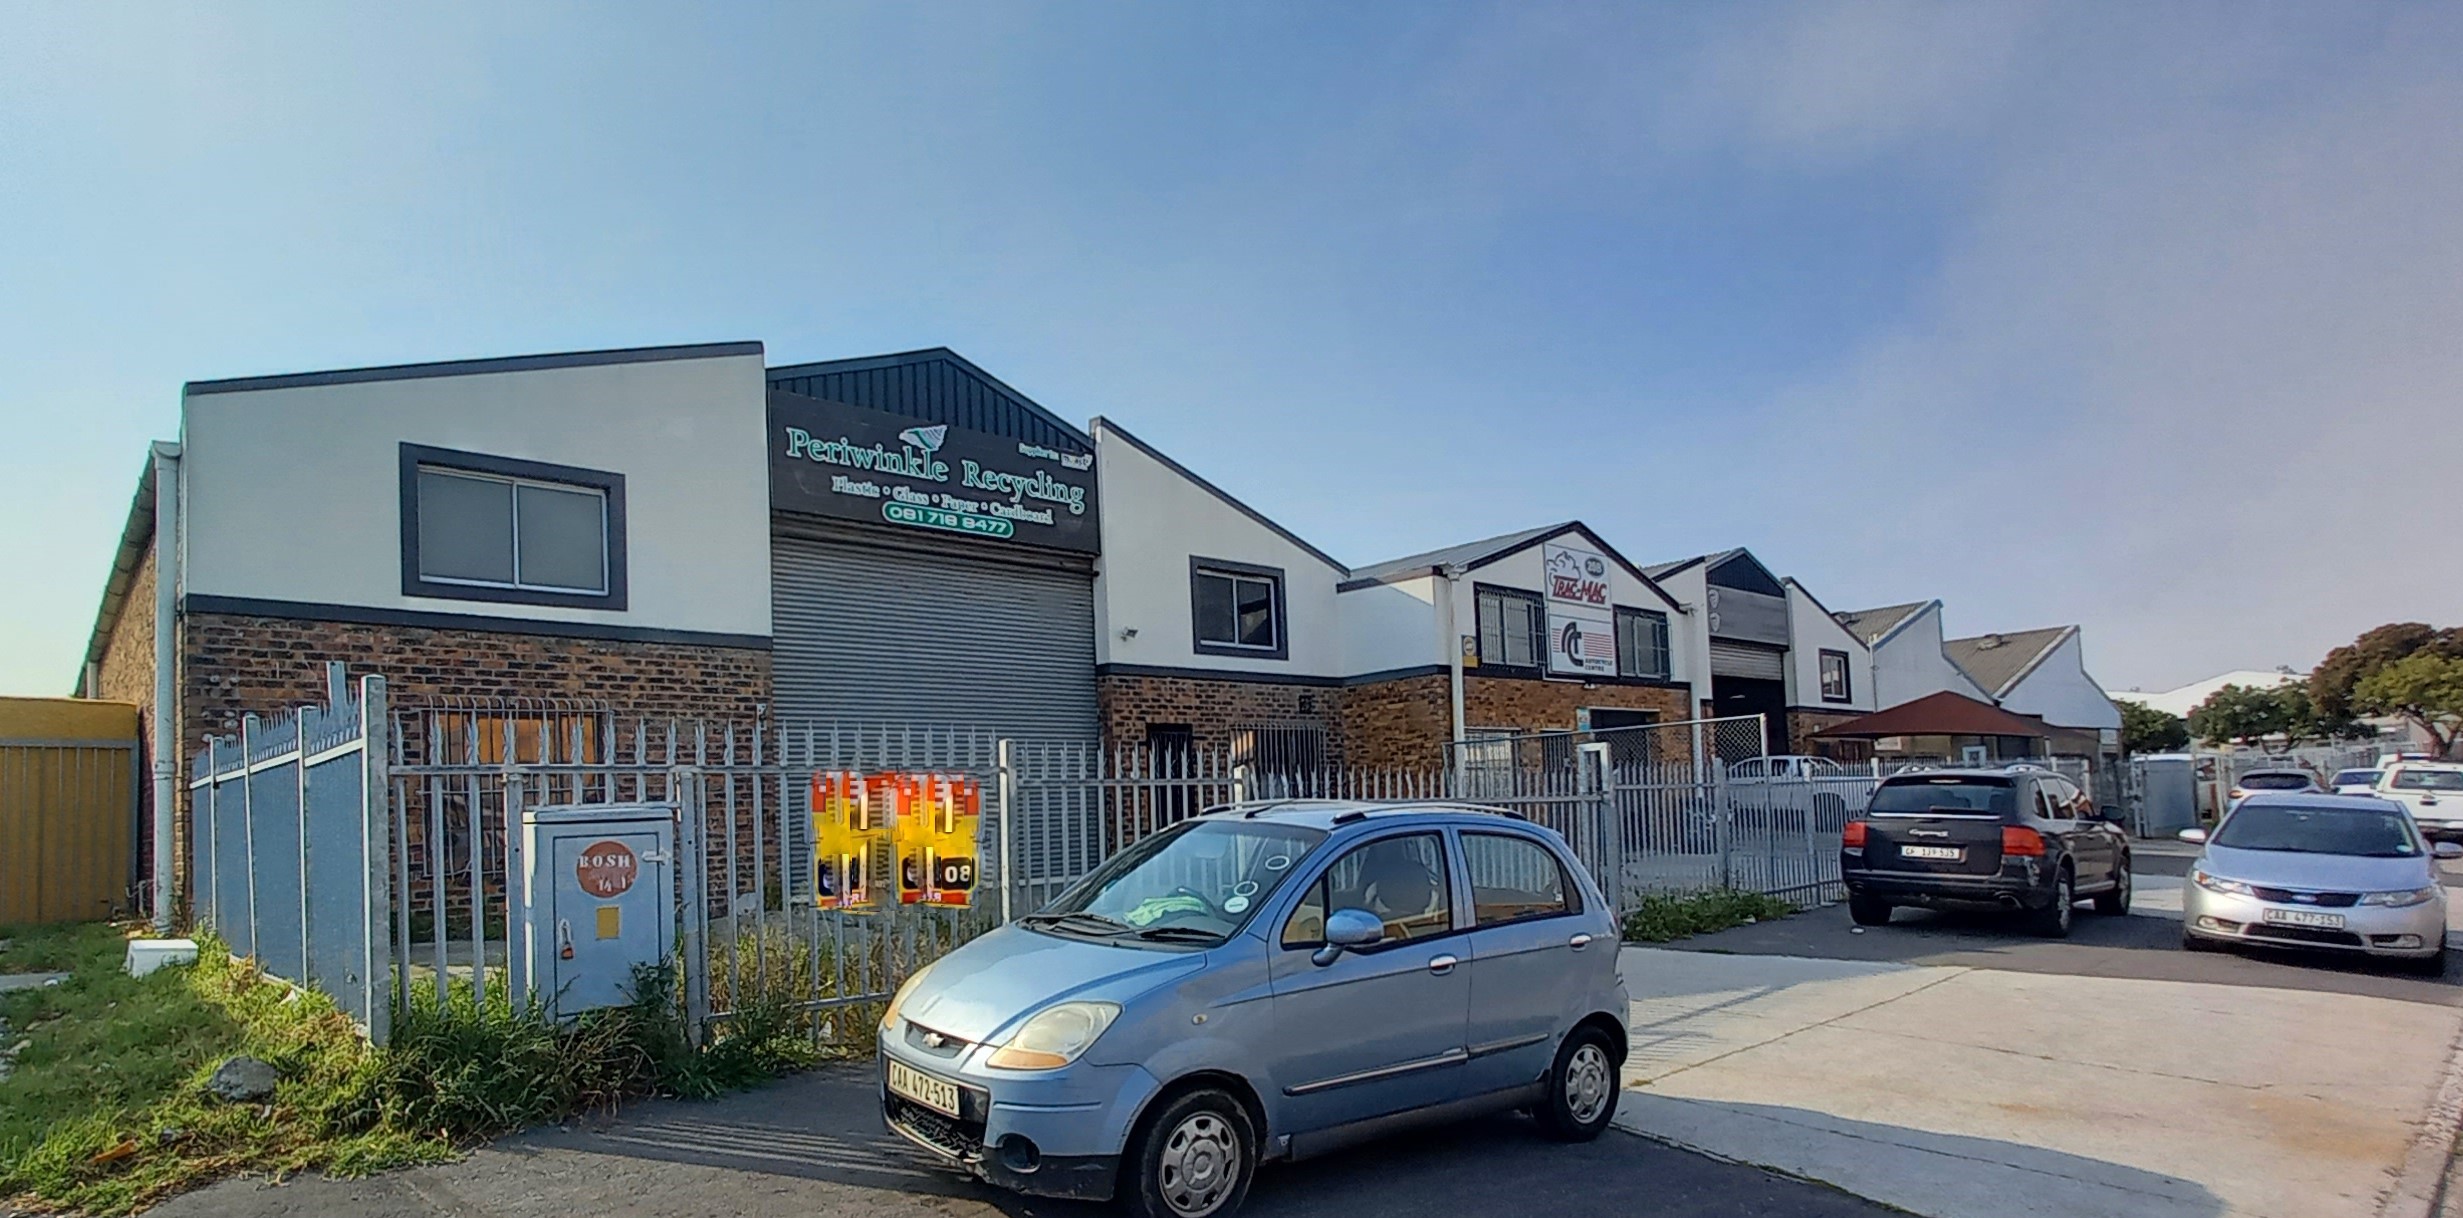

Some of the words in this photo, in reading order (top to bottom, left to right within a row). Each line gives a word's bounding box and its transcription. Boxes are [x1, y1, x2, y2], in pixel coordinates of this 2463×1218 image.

[785, 426, 949, 481] Periwinkle
[960, 459, 1086, 515] Recycling
[831, 475, 880, 498] Plastic
[891, 485, 930, 506] Glass
[940, 492, 979, 514] Paper
[989, 501, 1054, 525] Cardboard
[889, 506, 924, 522] 081
[927, 511, 958, 527] 718
[961, 516, 1007, 534] 8477
[2266, 909, 2287, 921] CAA
[892, 1064, 908, 1092] CAA
[913, 1073, 955, 1110] 472-513
